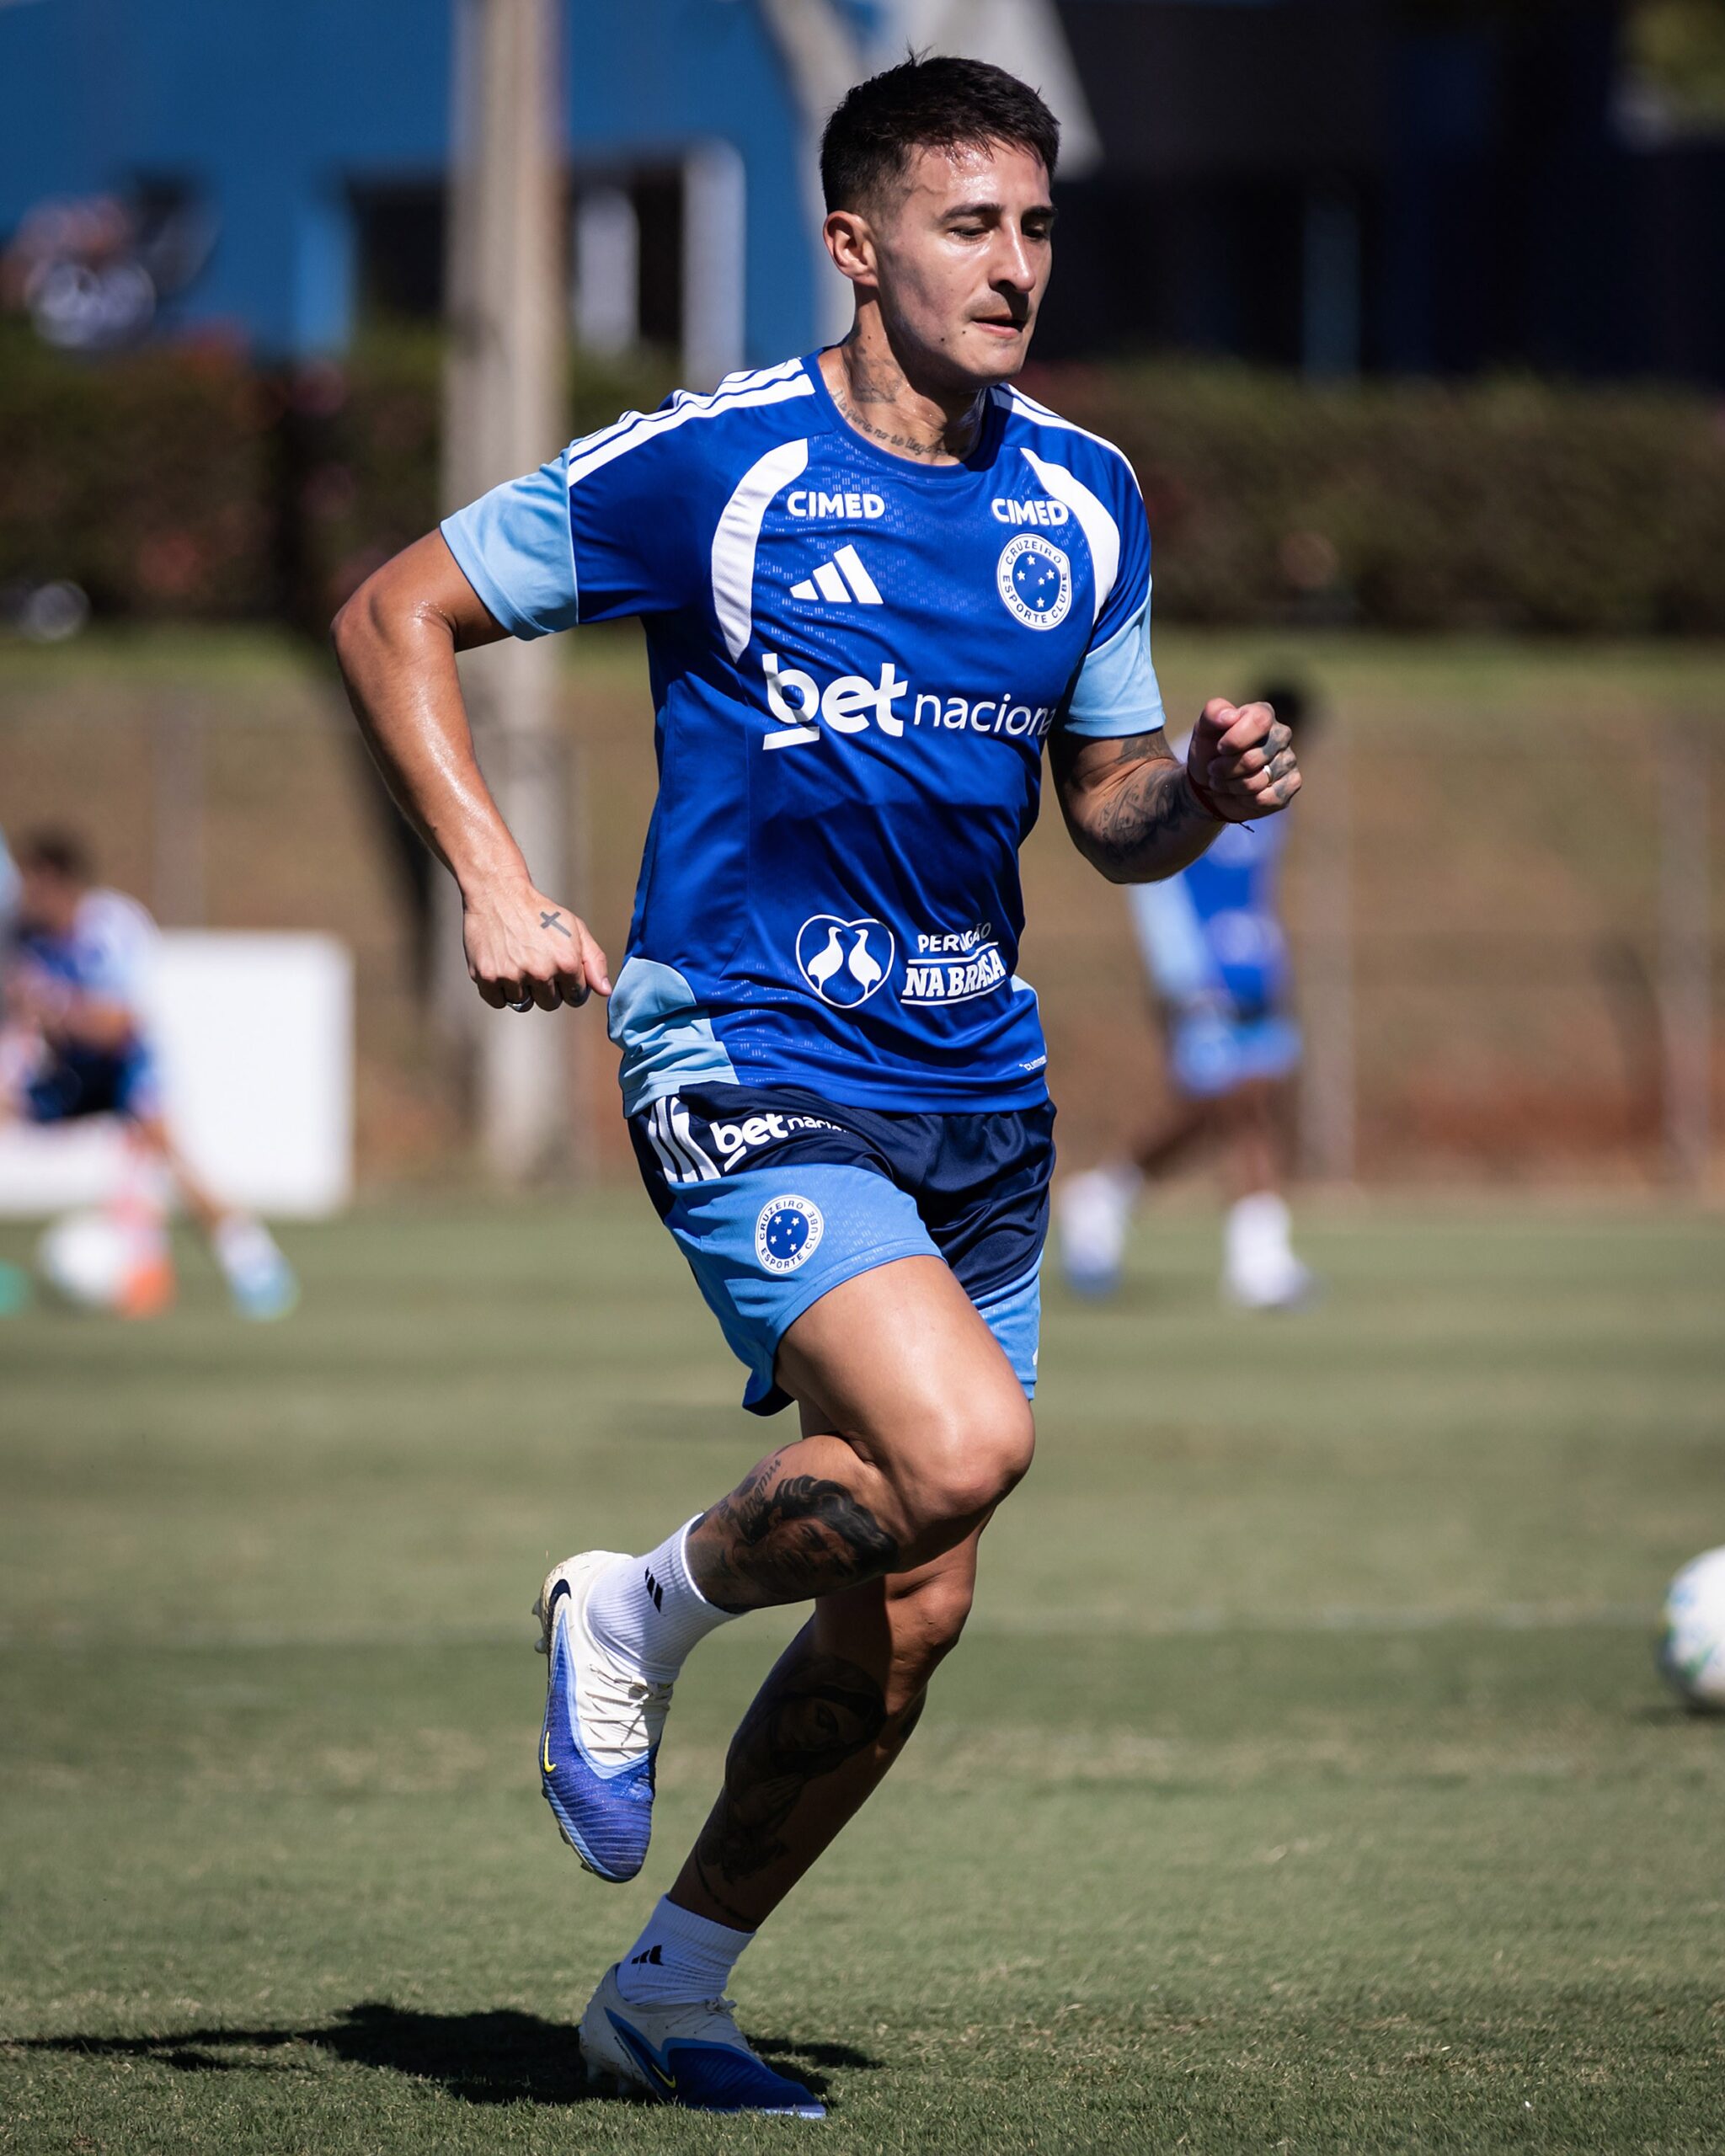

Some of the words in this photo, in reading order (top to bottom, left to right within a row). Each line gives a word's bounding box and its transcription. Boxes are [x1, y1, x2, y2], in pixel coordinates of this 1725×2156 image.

[787, 491, 885, 519] CIMED
[991, 498, 1069, 526] CIMED
[1006, 540, 1061, 565] CRUZEIRO
[1003, 575, 1048, 623] ESPORTE
[1051, 574, 1067, 618] CLUBE
[760, 1200, 804, 1241] CRUZEIRO
[761, 1247, 804, 1268] ESPORTE
[805, 1211, 819, 1250] CLUBE
